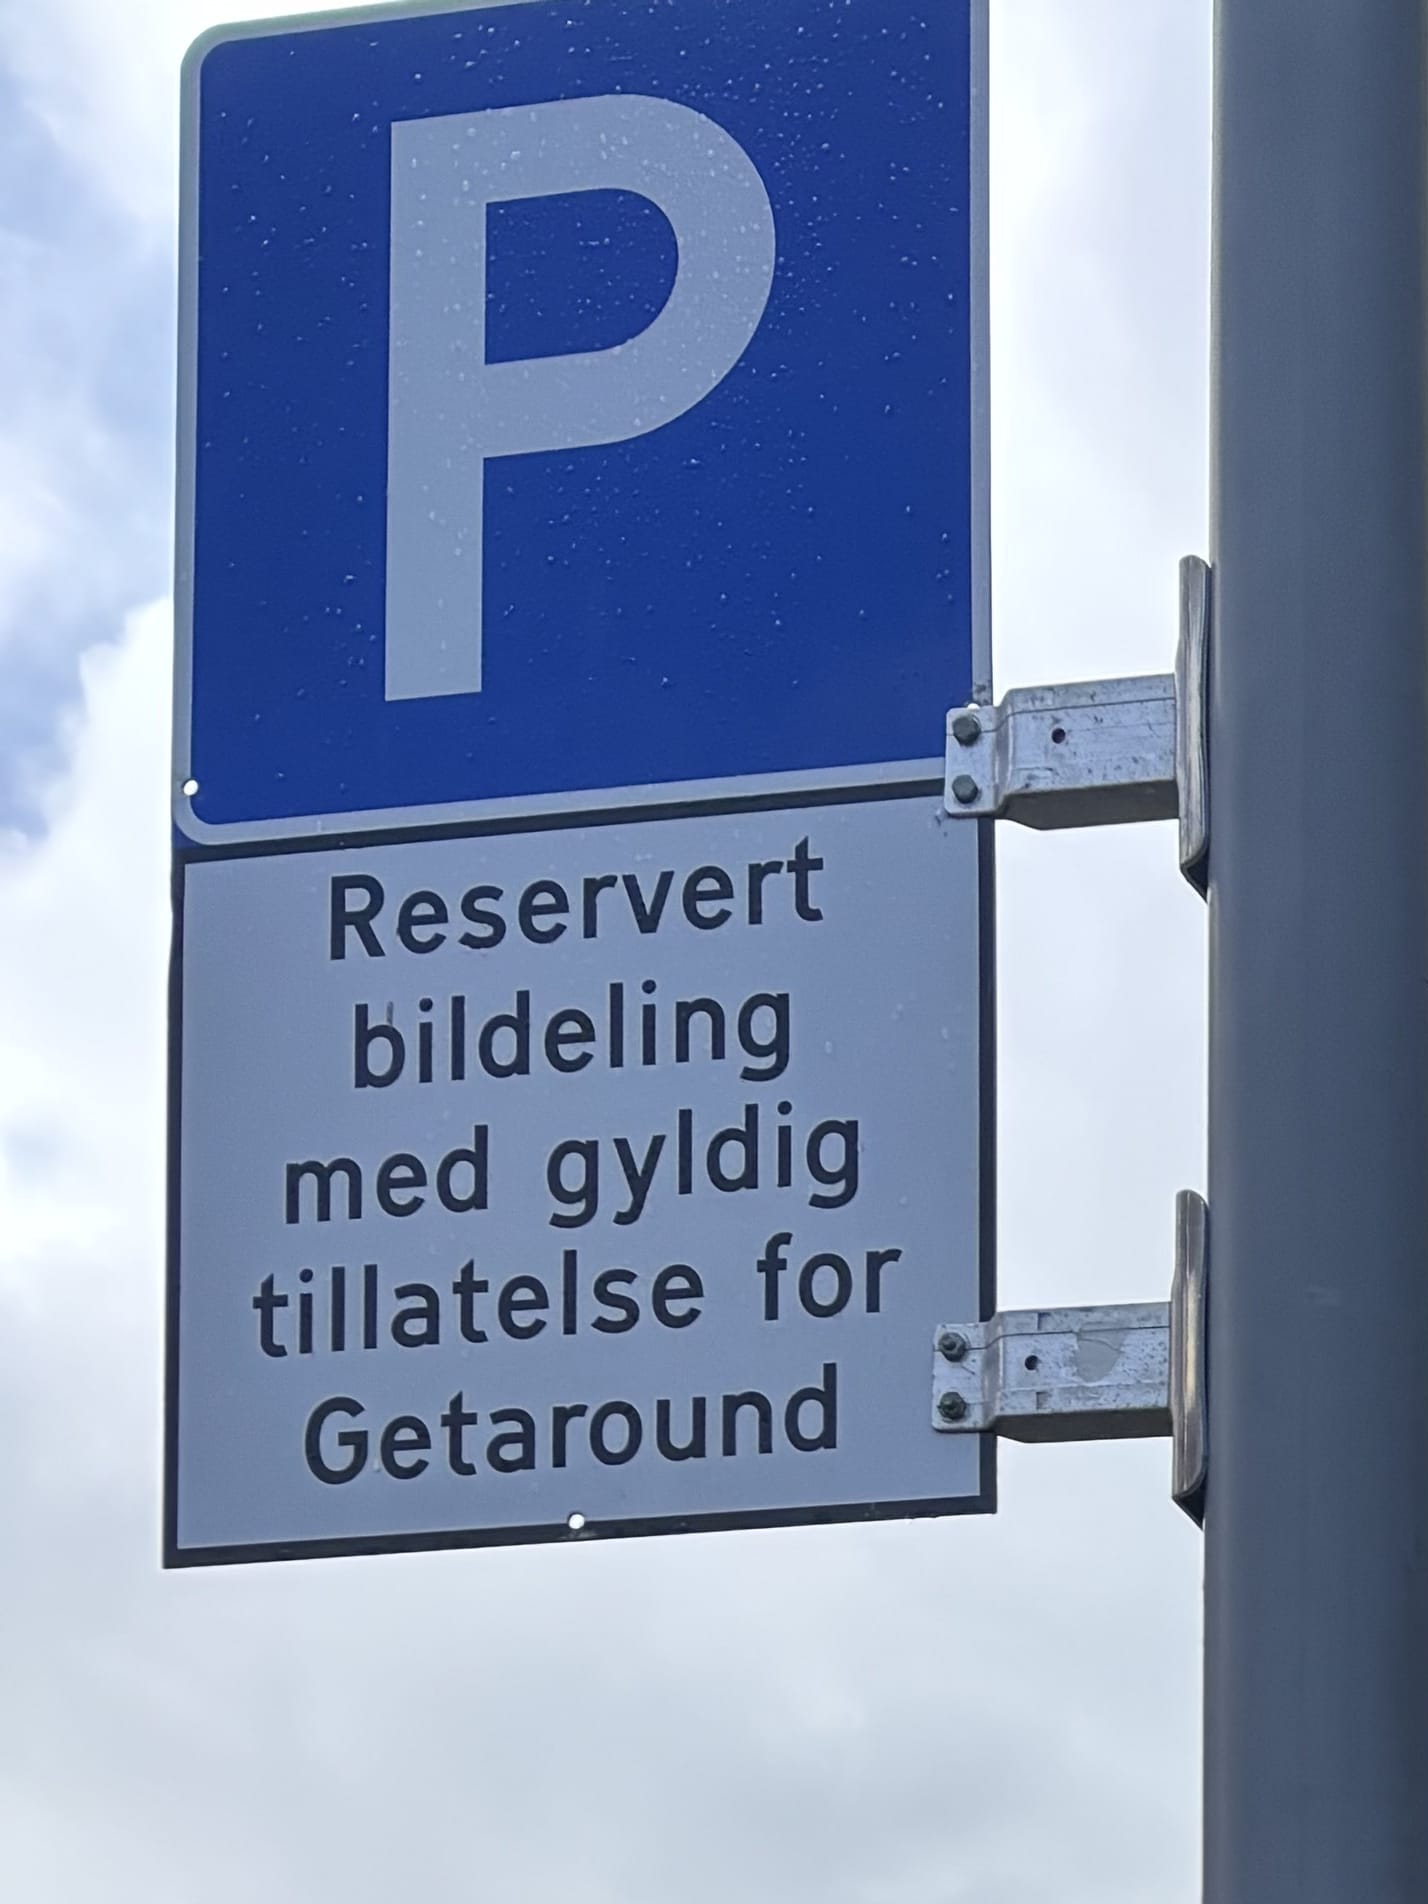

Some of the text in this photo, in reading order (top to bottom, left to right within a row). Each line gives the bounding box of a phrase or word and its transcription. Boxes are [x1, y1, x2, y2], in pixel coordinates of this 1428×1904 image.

[385, 92, 775, 701] P
[331, 837, 825, 960] Reservert
[353, 982, 792, 1089] bildeling
[285, 1102, 861, 1231] med gyldig
[254, 1235, 903, 1358] tillatelse for
[303, 1363, 841, 1486] Getaround
